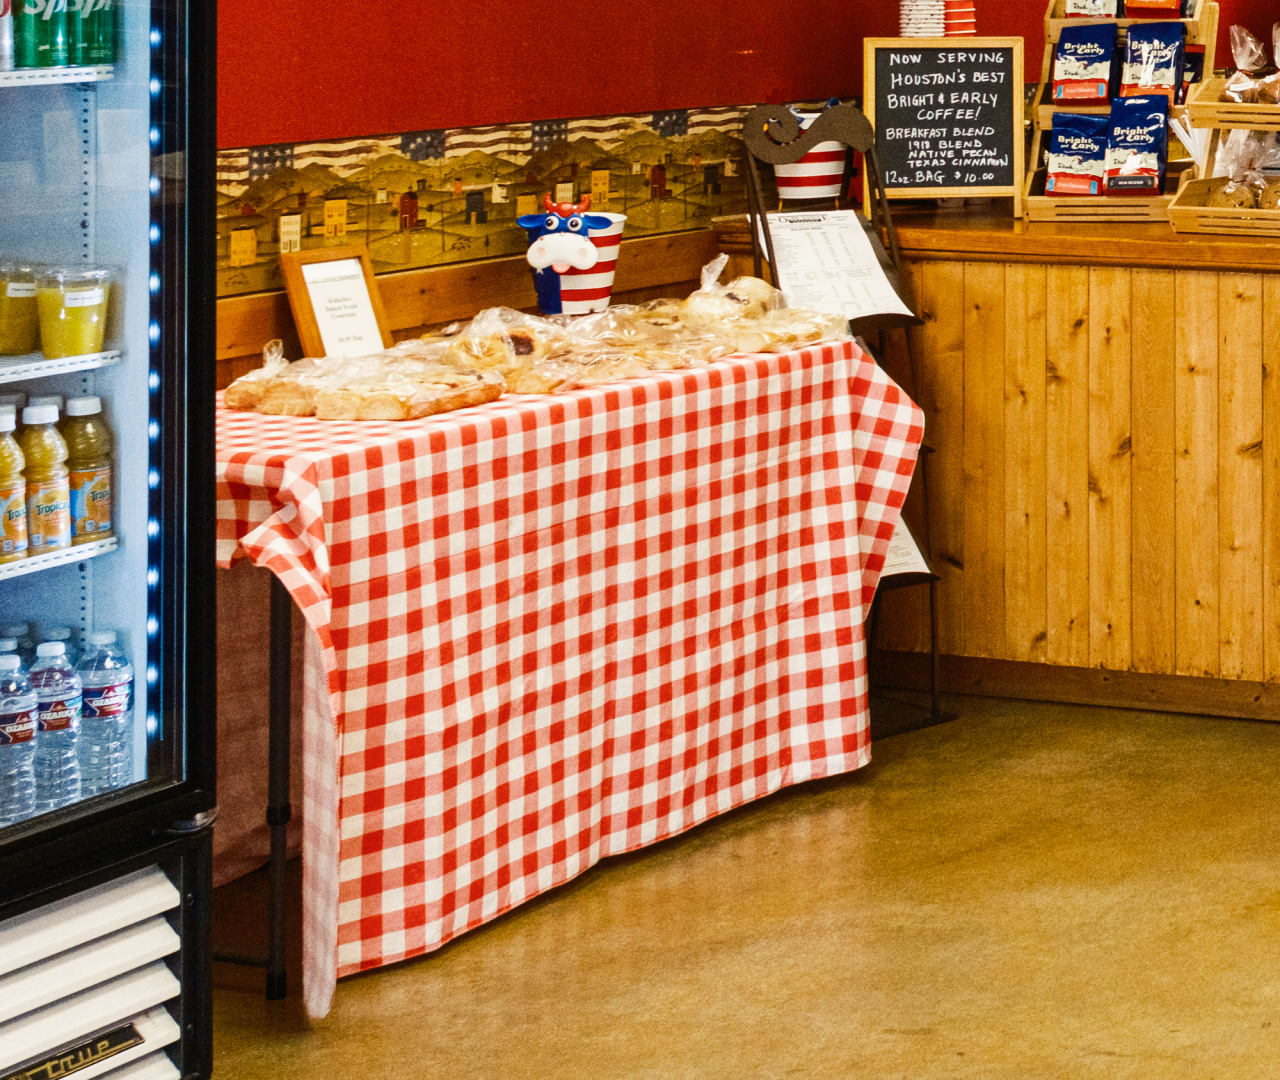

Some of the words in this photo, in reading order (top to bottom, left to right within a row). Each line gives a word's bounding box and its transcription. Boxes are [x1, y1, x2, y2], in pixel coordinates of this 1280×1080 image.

[1064, 42, 1099, 51] Bright
[1076, 47, 1105, 56] Early
[890, 54, 922, 66] NOW
[937, 52, 1004, 64] SERVING
[891, 69, 966, 89] HOUSTON'S
[973, 72, 1005, 84] BEST
[887, 93, 935, 109] BRIGHT
[938, 92, 945, 104] &
[950, 92, 998, 108] EARLY
[917, 106, 981, 120] COFFEE!
[886, 128, 948, 140] BREAKFAST
[953, 126, 995, 136] BLEND
[1113, 125, 1148, 137] Bright
[1058, 135, 1093, 145] Bright
[1126, 133, 1155, 144] Early
[908, 140, 930, 150] 1918
[938, 140, 983, 149] BLEND
[1071, 142, 1100, 153] Early
[908, 150, 955, 159] NATIVE
[962, 148, 997, 157] PECAN
[907, 159, 946, 168] TEXAS
[952, 154, 1009, 167] CINNAMON
[915, 170, 946, 183] BAG
